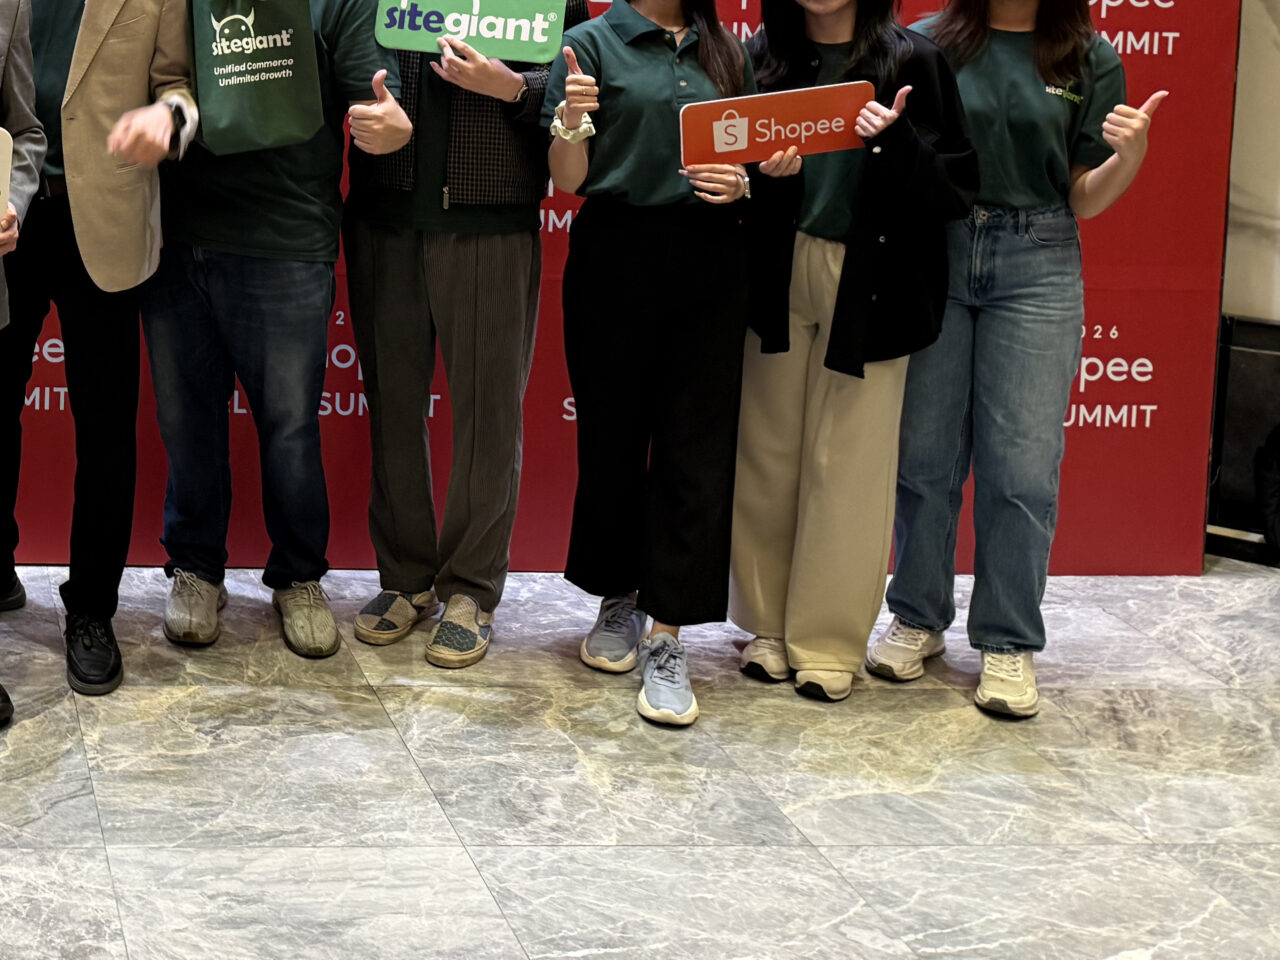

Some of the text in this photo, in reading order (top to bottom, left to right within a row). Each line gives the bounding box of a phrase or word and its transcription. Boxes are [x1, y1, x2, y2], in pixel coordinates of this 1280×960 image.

[213, 58, 294, 76] Unified Commerce
[218, 69, 293, 87] Unlimited Growth
[754, 117, 846, 144] Shopee
